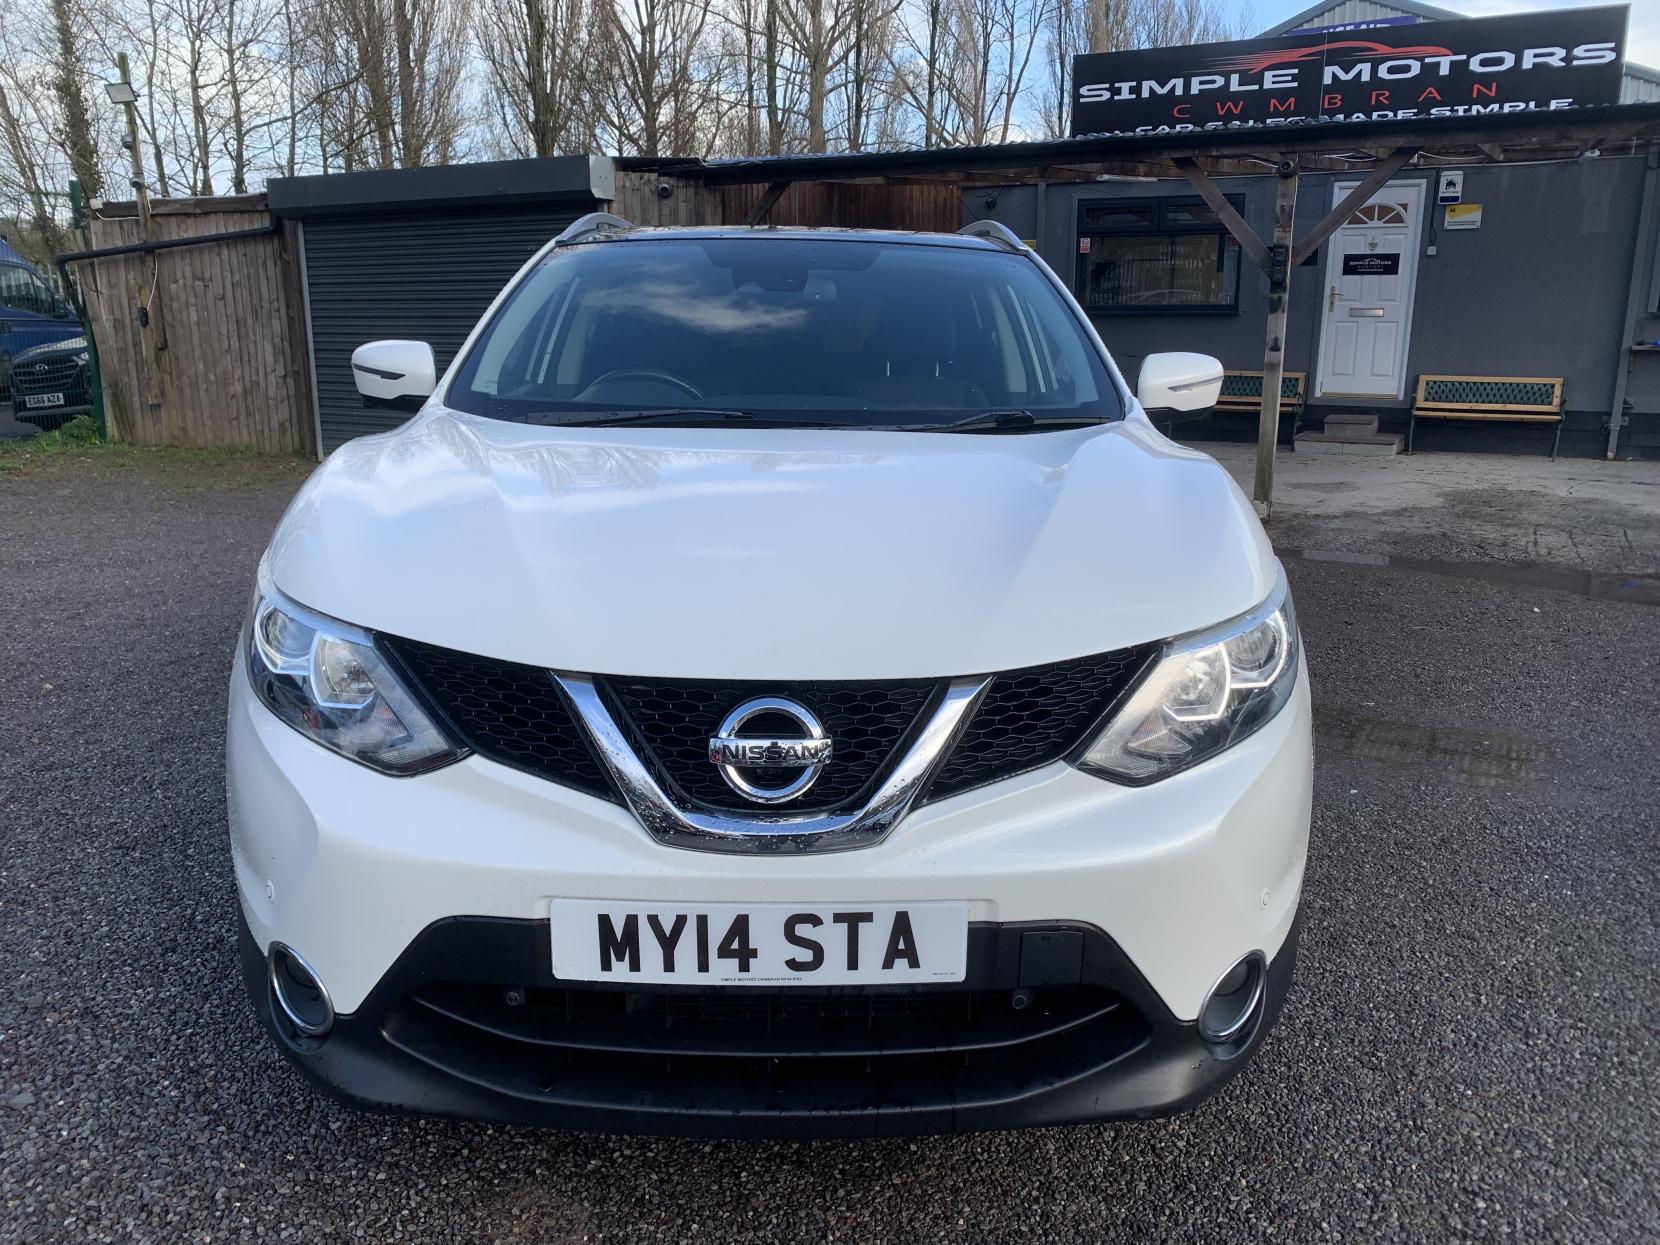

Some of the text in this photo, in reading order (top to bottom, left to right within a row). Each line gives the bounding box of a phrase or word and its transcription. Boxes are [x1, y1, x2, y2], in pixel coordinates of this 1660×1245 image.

[1079, 42, 1616, 103] SIMPLE MOTORS
[1430, 98, 1573, 118] SIMPLE
[722, 744, 820, 761] NISSAN
[597, 910, 921, 973] MY14 STA
